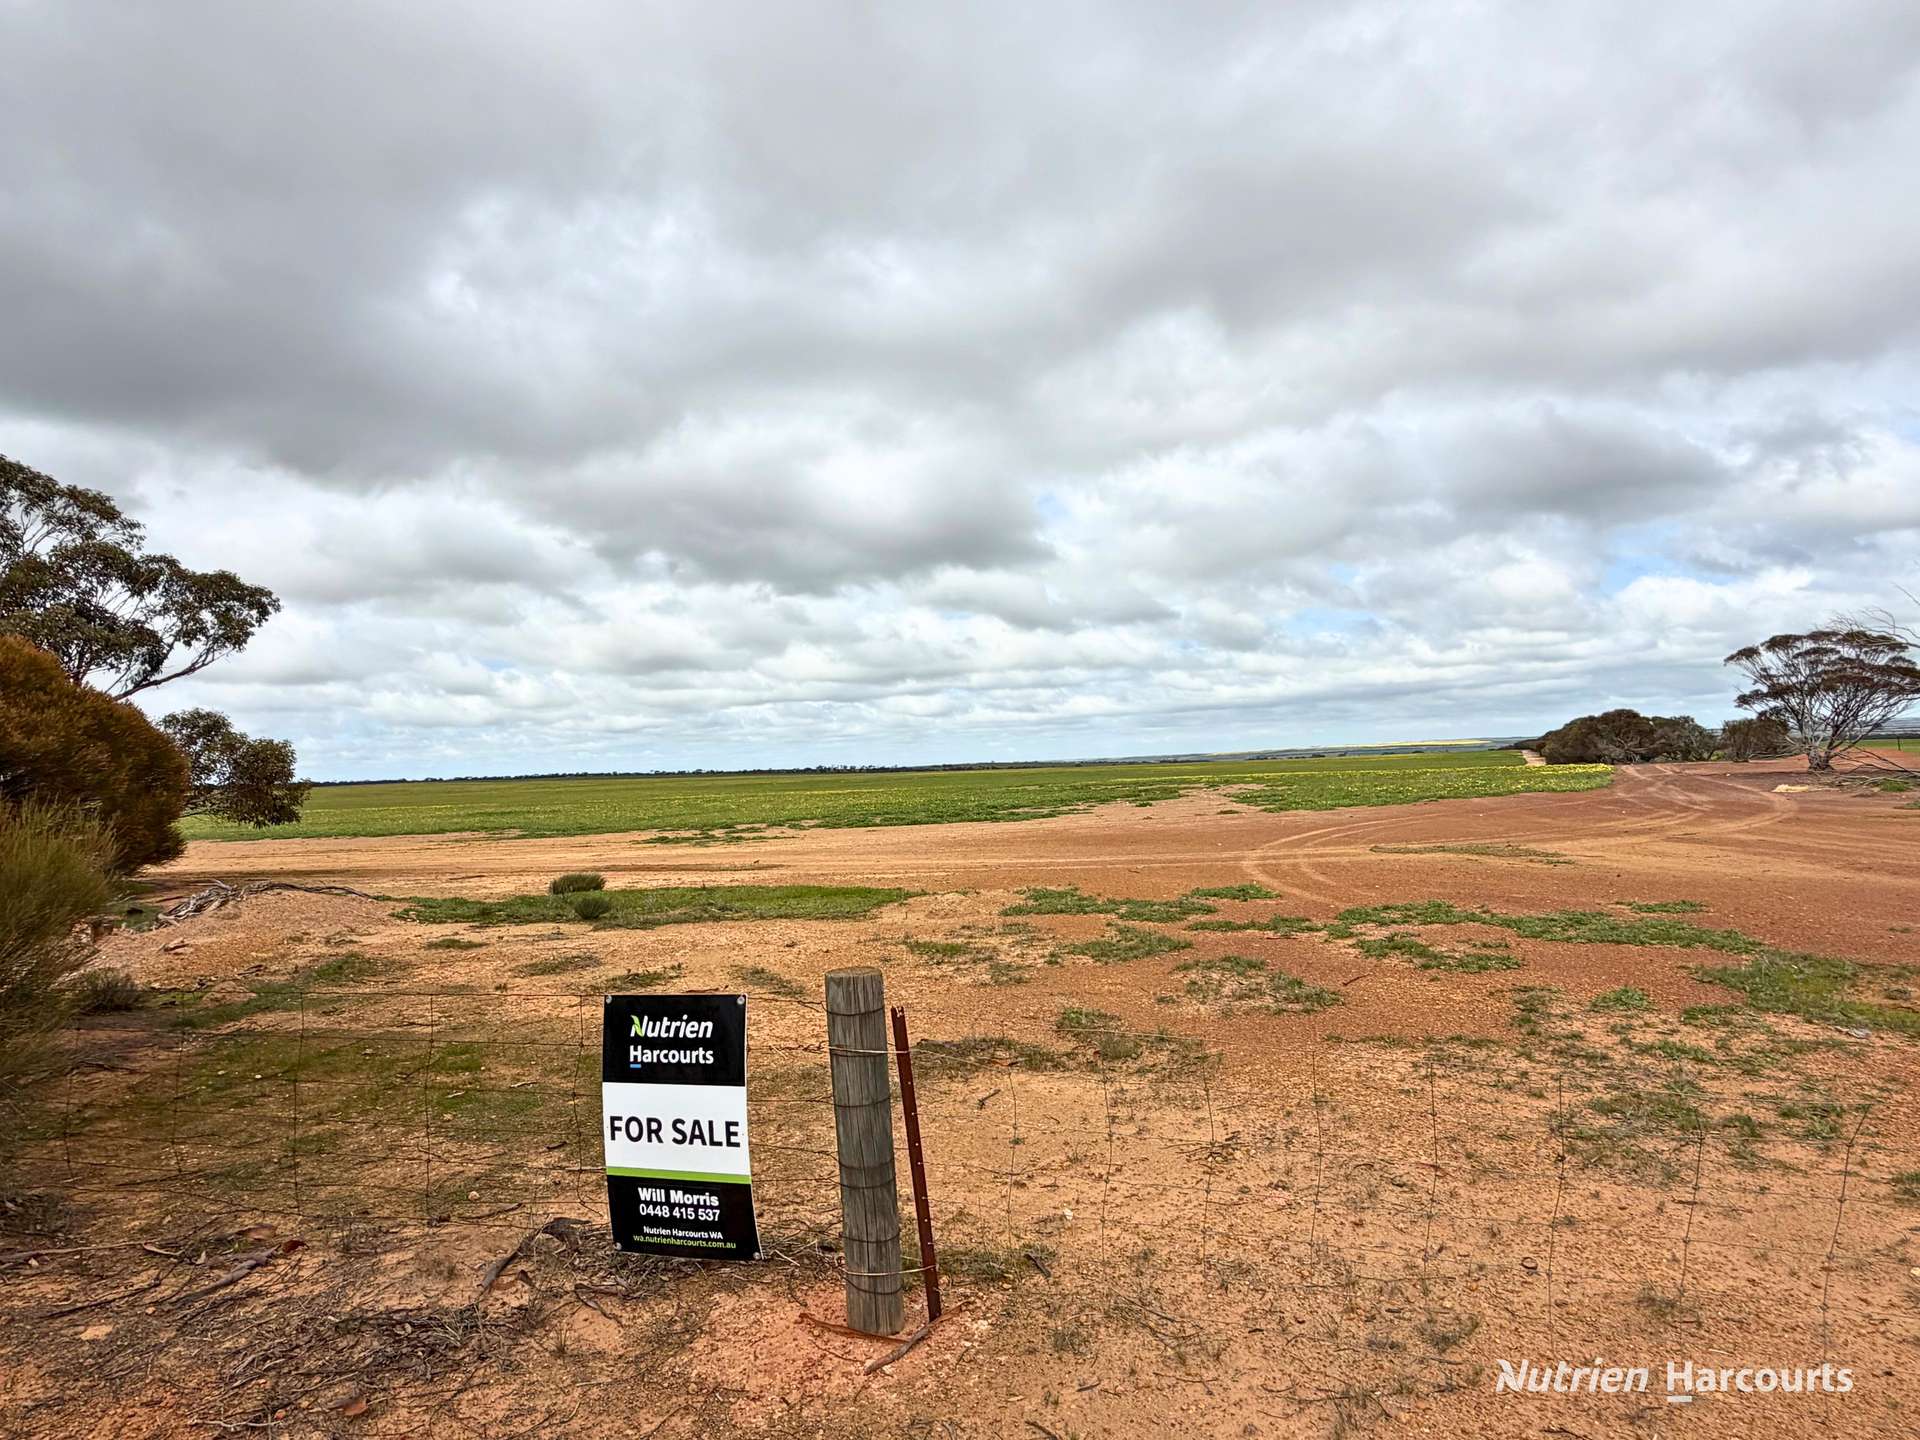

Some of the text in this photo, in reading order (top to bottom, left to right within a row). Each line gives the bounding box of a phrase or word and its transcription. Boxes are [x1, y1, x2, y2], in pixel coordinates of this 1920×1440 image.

[630, 1014, 713, 1039] Nutrien
[629, 1045, 714, 1064] Harcourts
[610, 1115, 741, 1148] FOR SALE
[638, 1187, 719, 1206] Will Morris
[640, 1204, 720, 1221] 0448 415 537
[633, 1234, 737, 1249] wa.nutrienharcourts.com.au
[643, 1225, 723, 1240] Nutrien Harcourts WA
